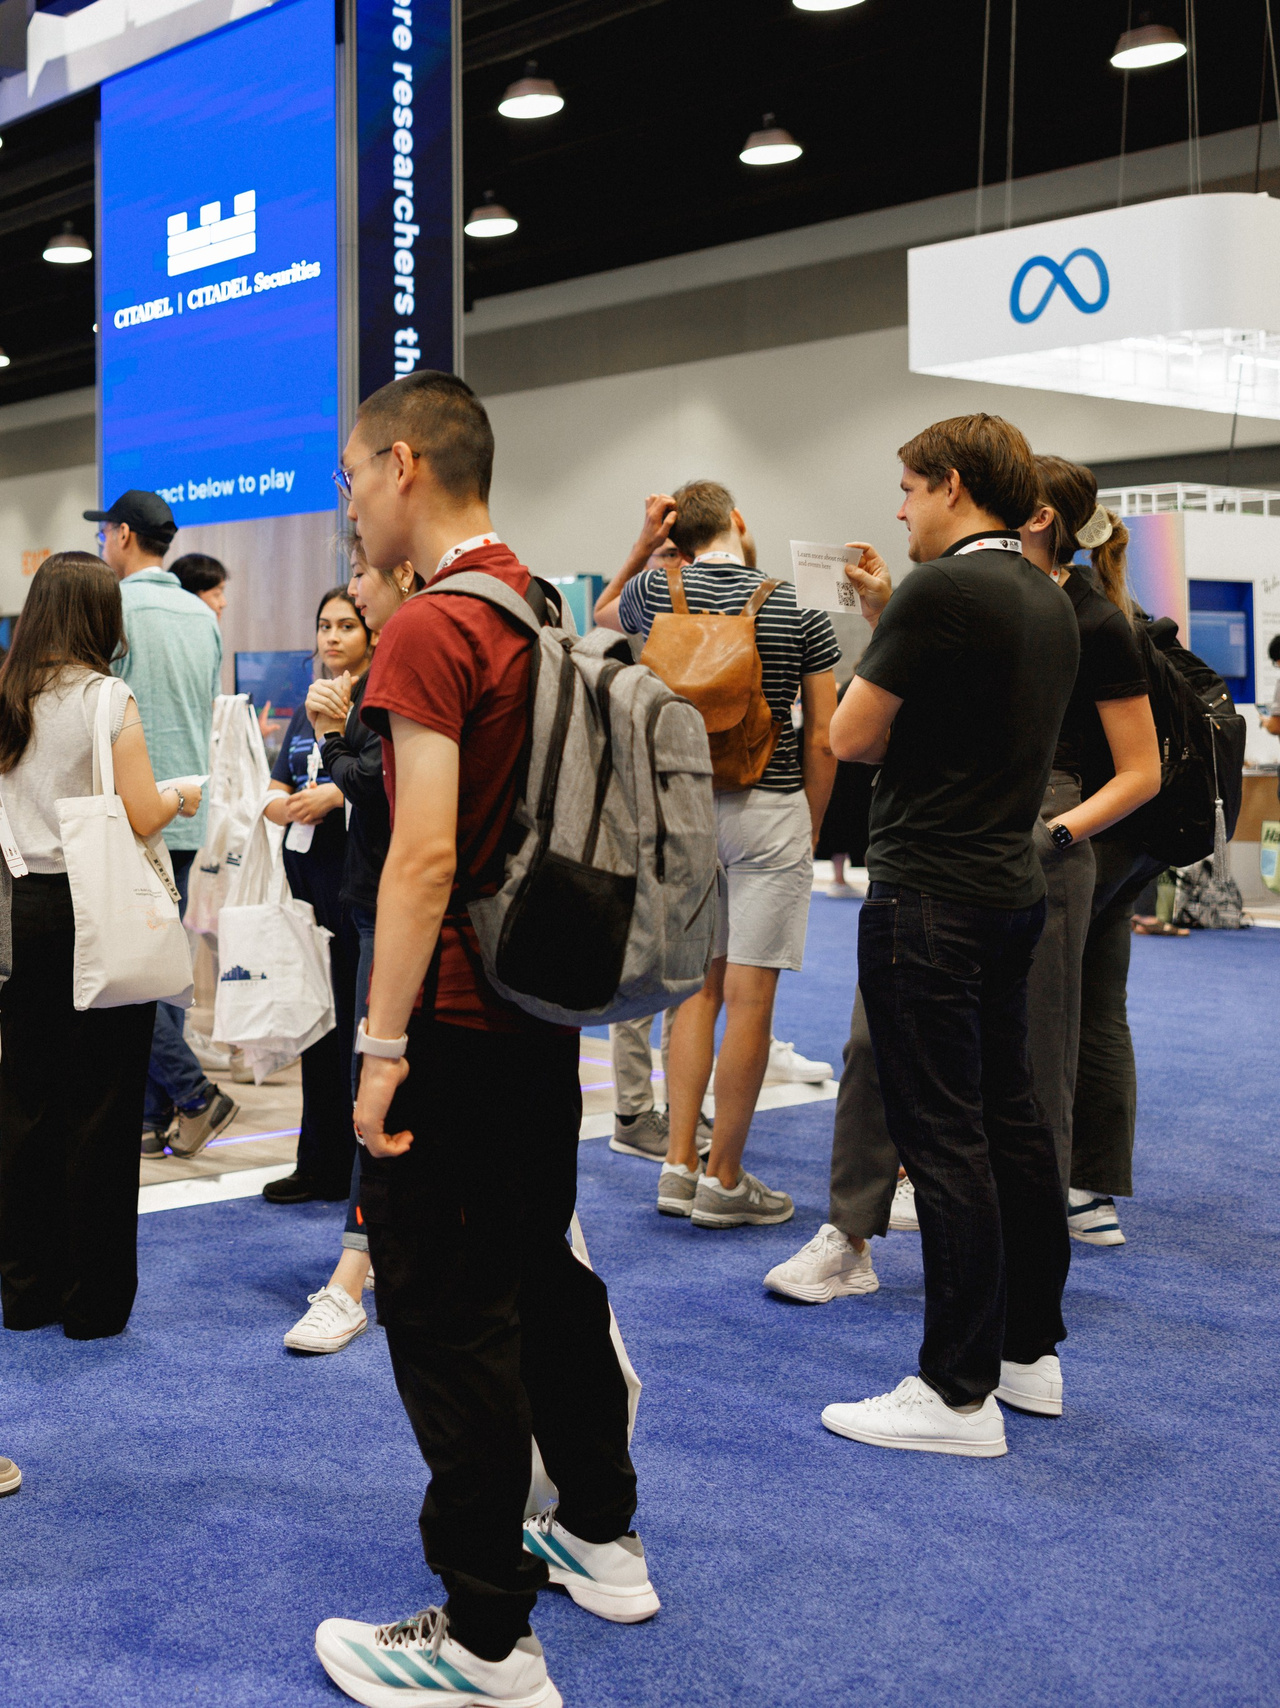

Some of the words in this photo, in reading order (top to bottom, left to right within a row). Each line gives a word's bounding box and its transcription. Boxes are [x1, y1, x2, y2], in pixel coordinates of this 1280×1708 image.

[392, 61, 420, 316] researchers
[114, 297, 173, 329] CITADEL
[187, 276, 252, 310] CITADEL
[254, 260, 321, 293] Securities
[187, 477, 235, 501] below
[238, 474, 256, 493] to
[259, 468, 295, 496] play
